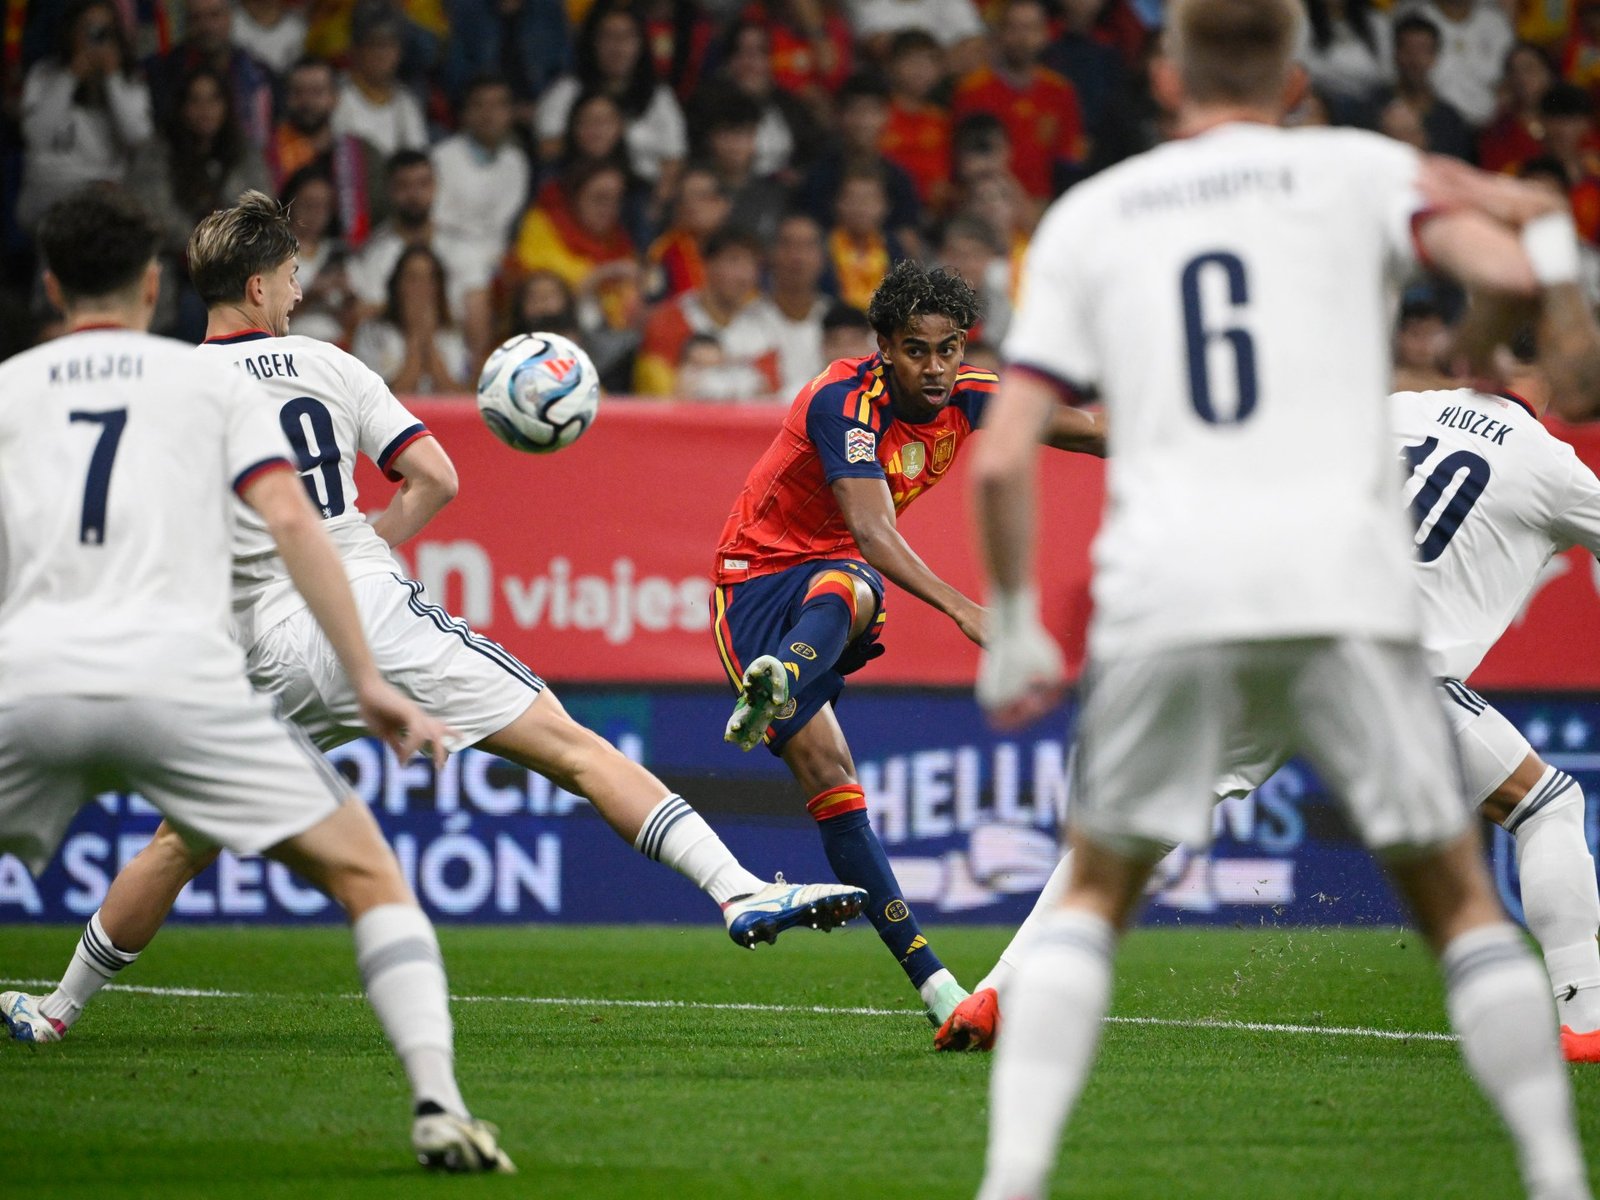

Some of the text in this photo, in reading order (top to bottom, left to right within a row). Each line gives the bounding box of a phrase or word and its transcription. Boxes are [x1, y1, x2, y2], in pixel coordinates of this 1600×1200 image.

[232, 353, 299, 381] ACEK
[1180, 250, 1263, 427] 6
[69, 406, 128, 545] 7
[279, 396, 345, 520] 9
[502, 556, 712, 646] viajes
